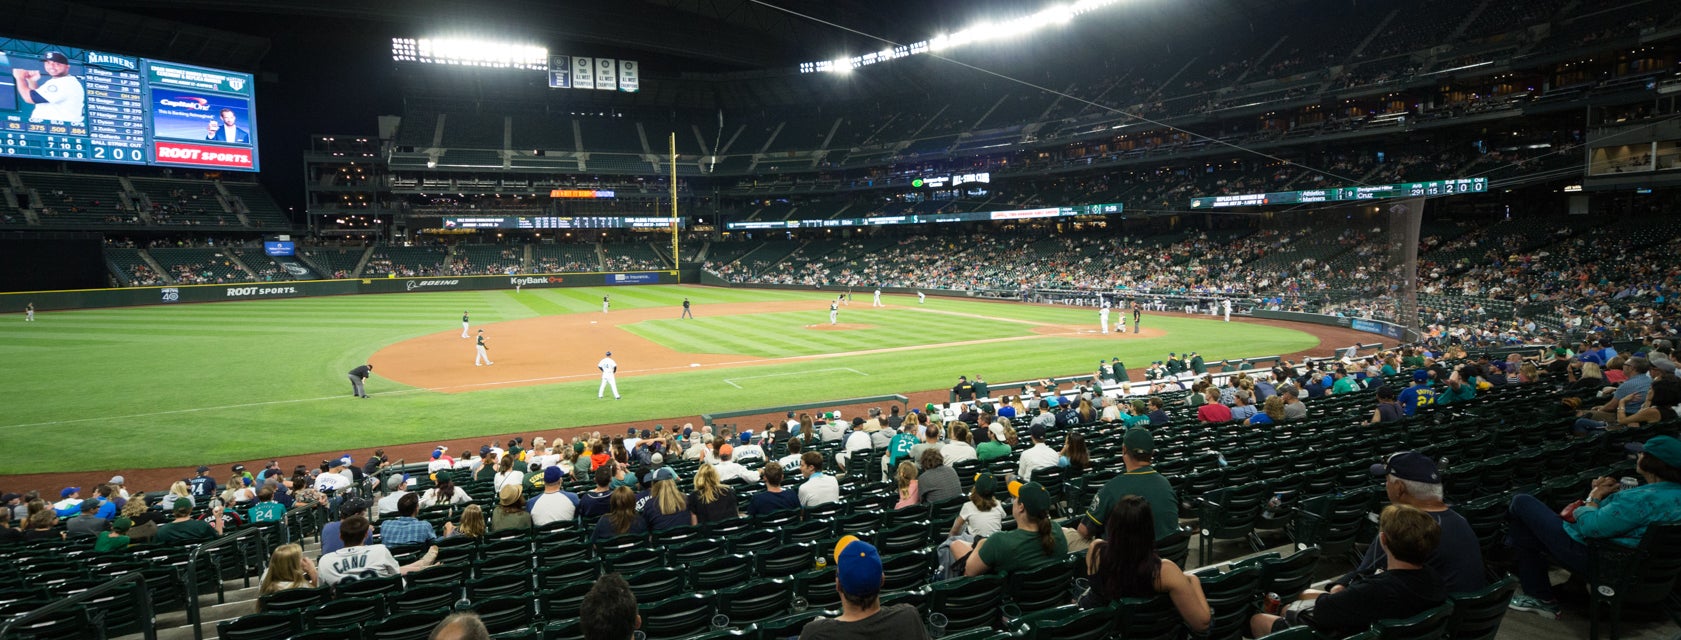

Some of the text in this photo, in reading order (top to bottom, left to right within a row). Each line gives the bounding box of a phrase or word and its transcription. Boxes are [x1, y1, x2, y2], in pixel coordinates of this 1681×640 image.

[88, 52, 135, 69] MARINERS
[94, 147, 142, 160] 2 0 0
[159, 147, 201, 160] ROOT
[953, 174, 975, 186] ALL-STAR
[976, 173, 989, 183] CLUB
[511, 277, 548, 285] KeyBank
[227, 287, 258, 296] ROOT
[256, 509, 272, 522] 24
